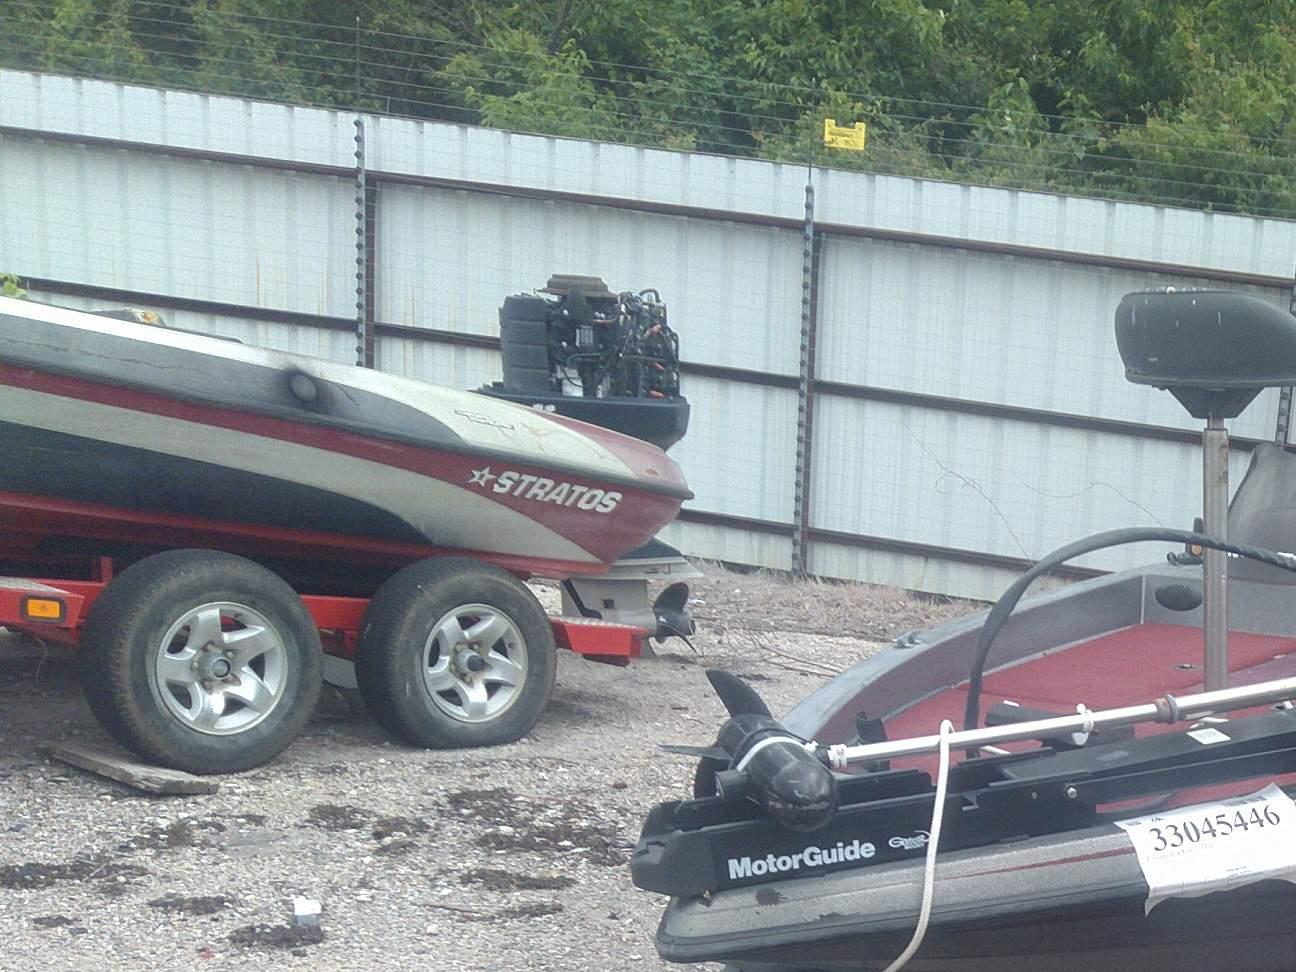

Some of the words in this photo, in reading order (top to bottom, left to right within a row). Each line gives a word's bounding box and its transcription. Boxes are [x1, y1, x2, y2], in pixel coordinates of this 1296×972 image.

[492, 471, 623, 514] STRATOS
[1149, 804, 1281, 852] 33045446
[727, 839, 876, 880] MotorGuide
